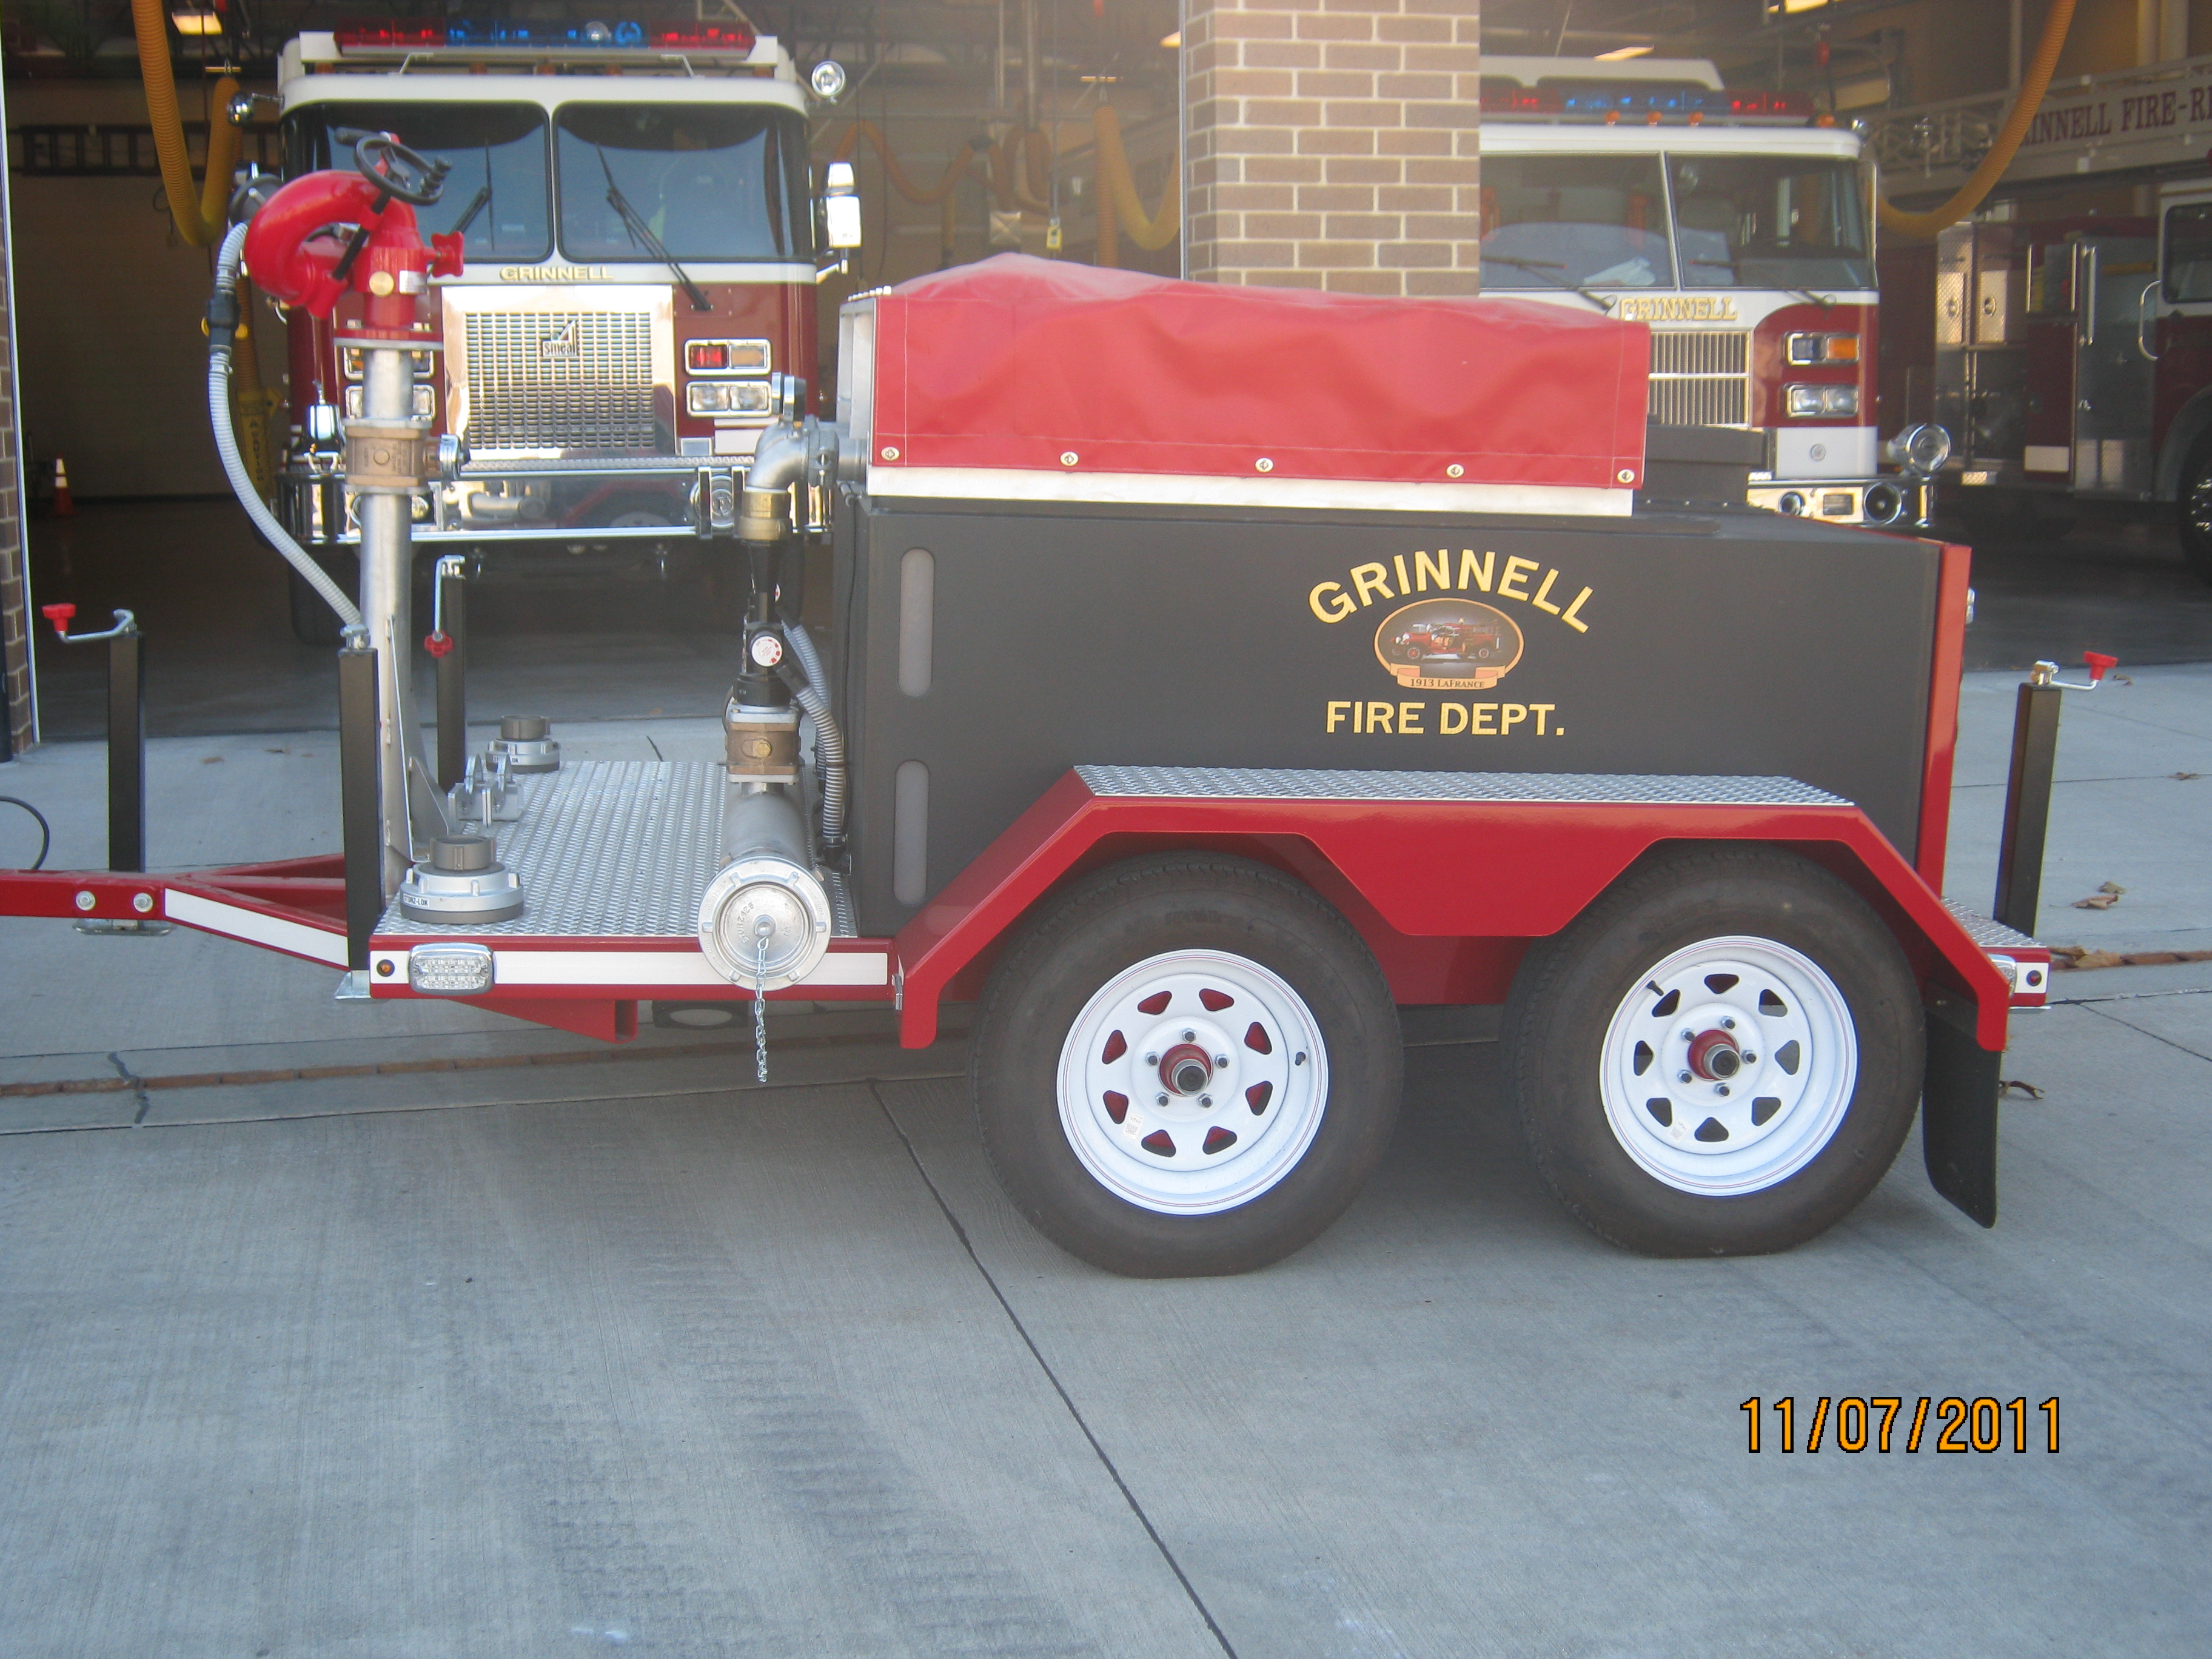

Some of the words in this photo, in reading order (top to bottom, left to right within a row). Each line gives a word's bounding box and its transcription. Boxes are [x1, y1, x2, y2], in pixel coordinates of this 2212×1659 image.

[2020, 102, 2112, 146] INNELL
[500, 266, 614, 281] GRINNELL
[1620, 296, 1738, 321] GRINNELL
[1309, 548, 1594, 634] GRINNELL
[1410, 678, 1435, 688] 1913
[1326, 700, 1426, 734] FIRE
[1439, 702, 1566, 736] DEPT.
